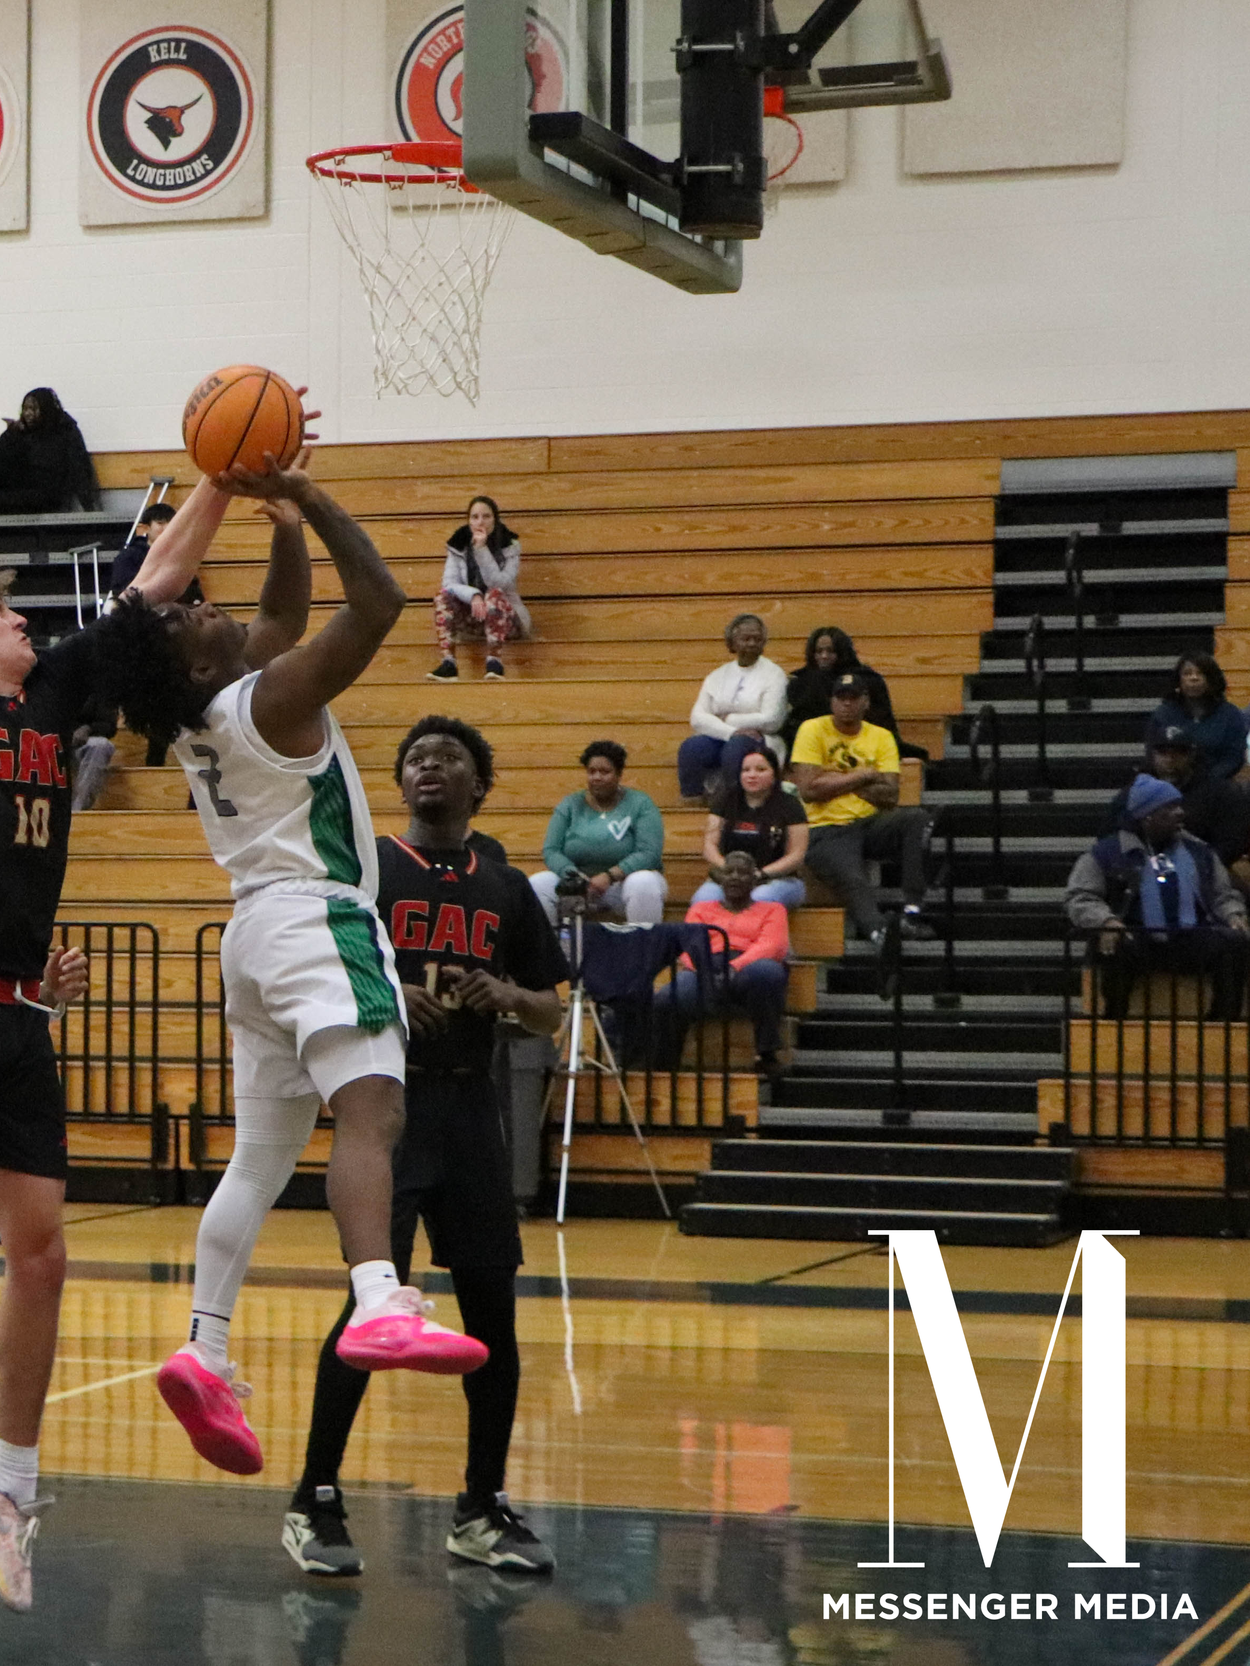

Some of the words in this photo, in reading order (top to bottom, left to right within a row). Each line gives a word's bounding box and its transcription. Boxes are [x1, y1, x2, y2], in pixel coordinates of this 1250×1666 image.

[148, 42, 187, 63] KELL
[126, 154, 214, 186] LONGHORNS
[14, 795, 50, 848] 10
[391, 900, 500, 960] GAC
